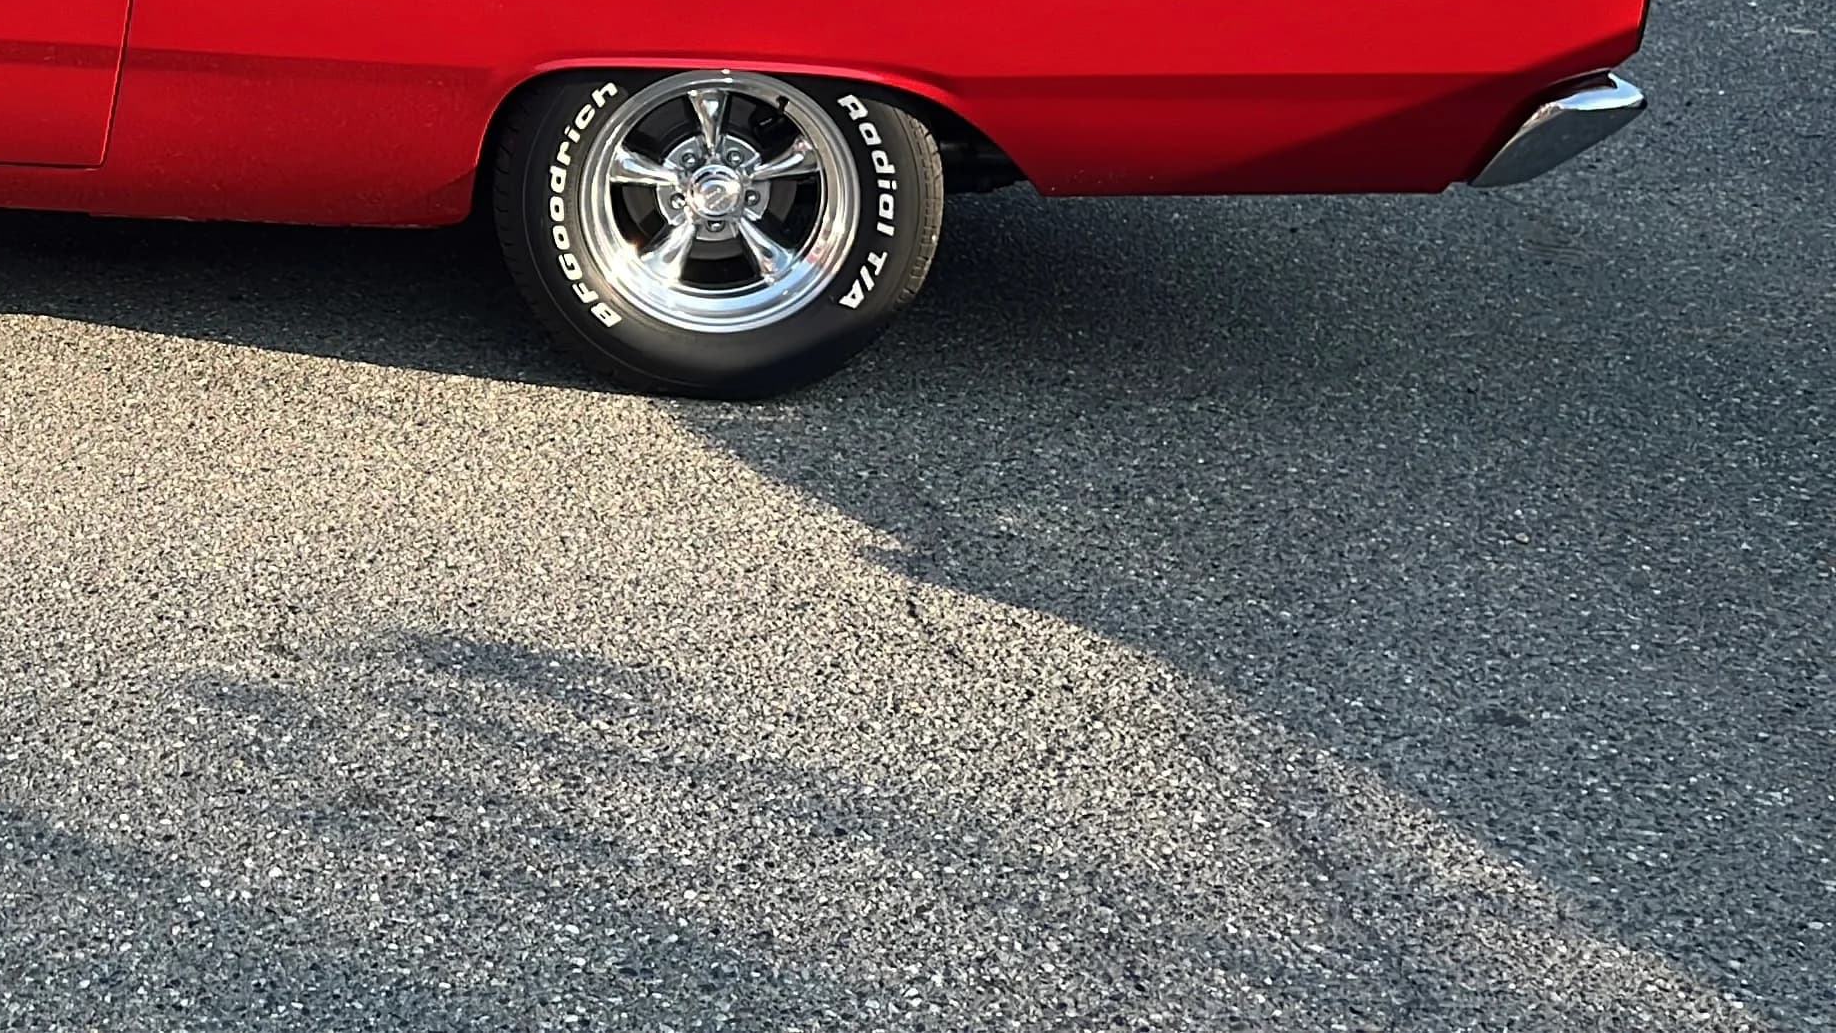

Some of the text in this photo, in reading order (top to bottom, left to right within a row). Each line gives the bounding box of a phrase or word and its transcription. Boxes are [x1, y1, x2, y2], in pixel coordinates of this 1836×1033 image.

[548, 81, 624, 329] BFGoodrich
[836, 93, 899, 310] Radial T/A
